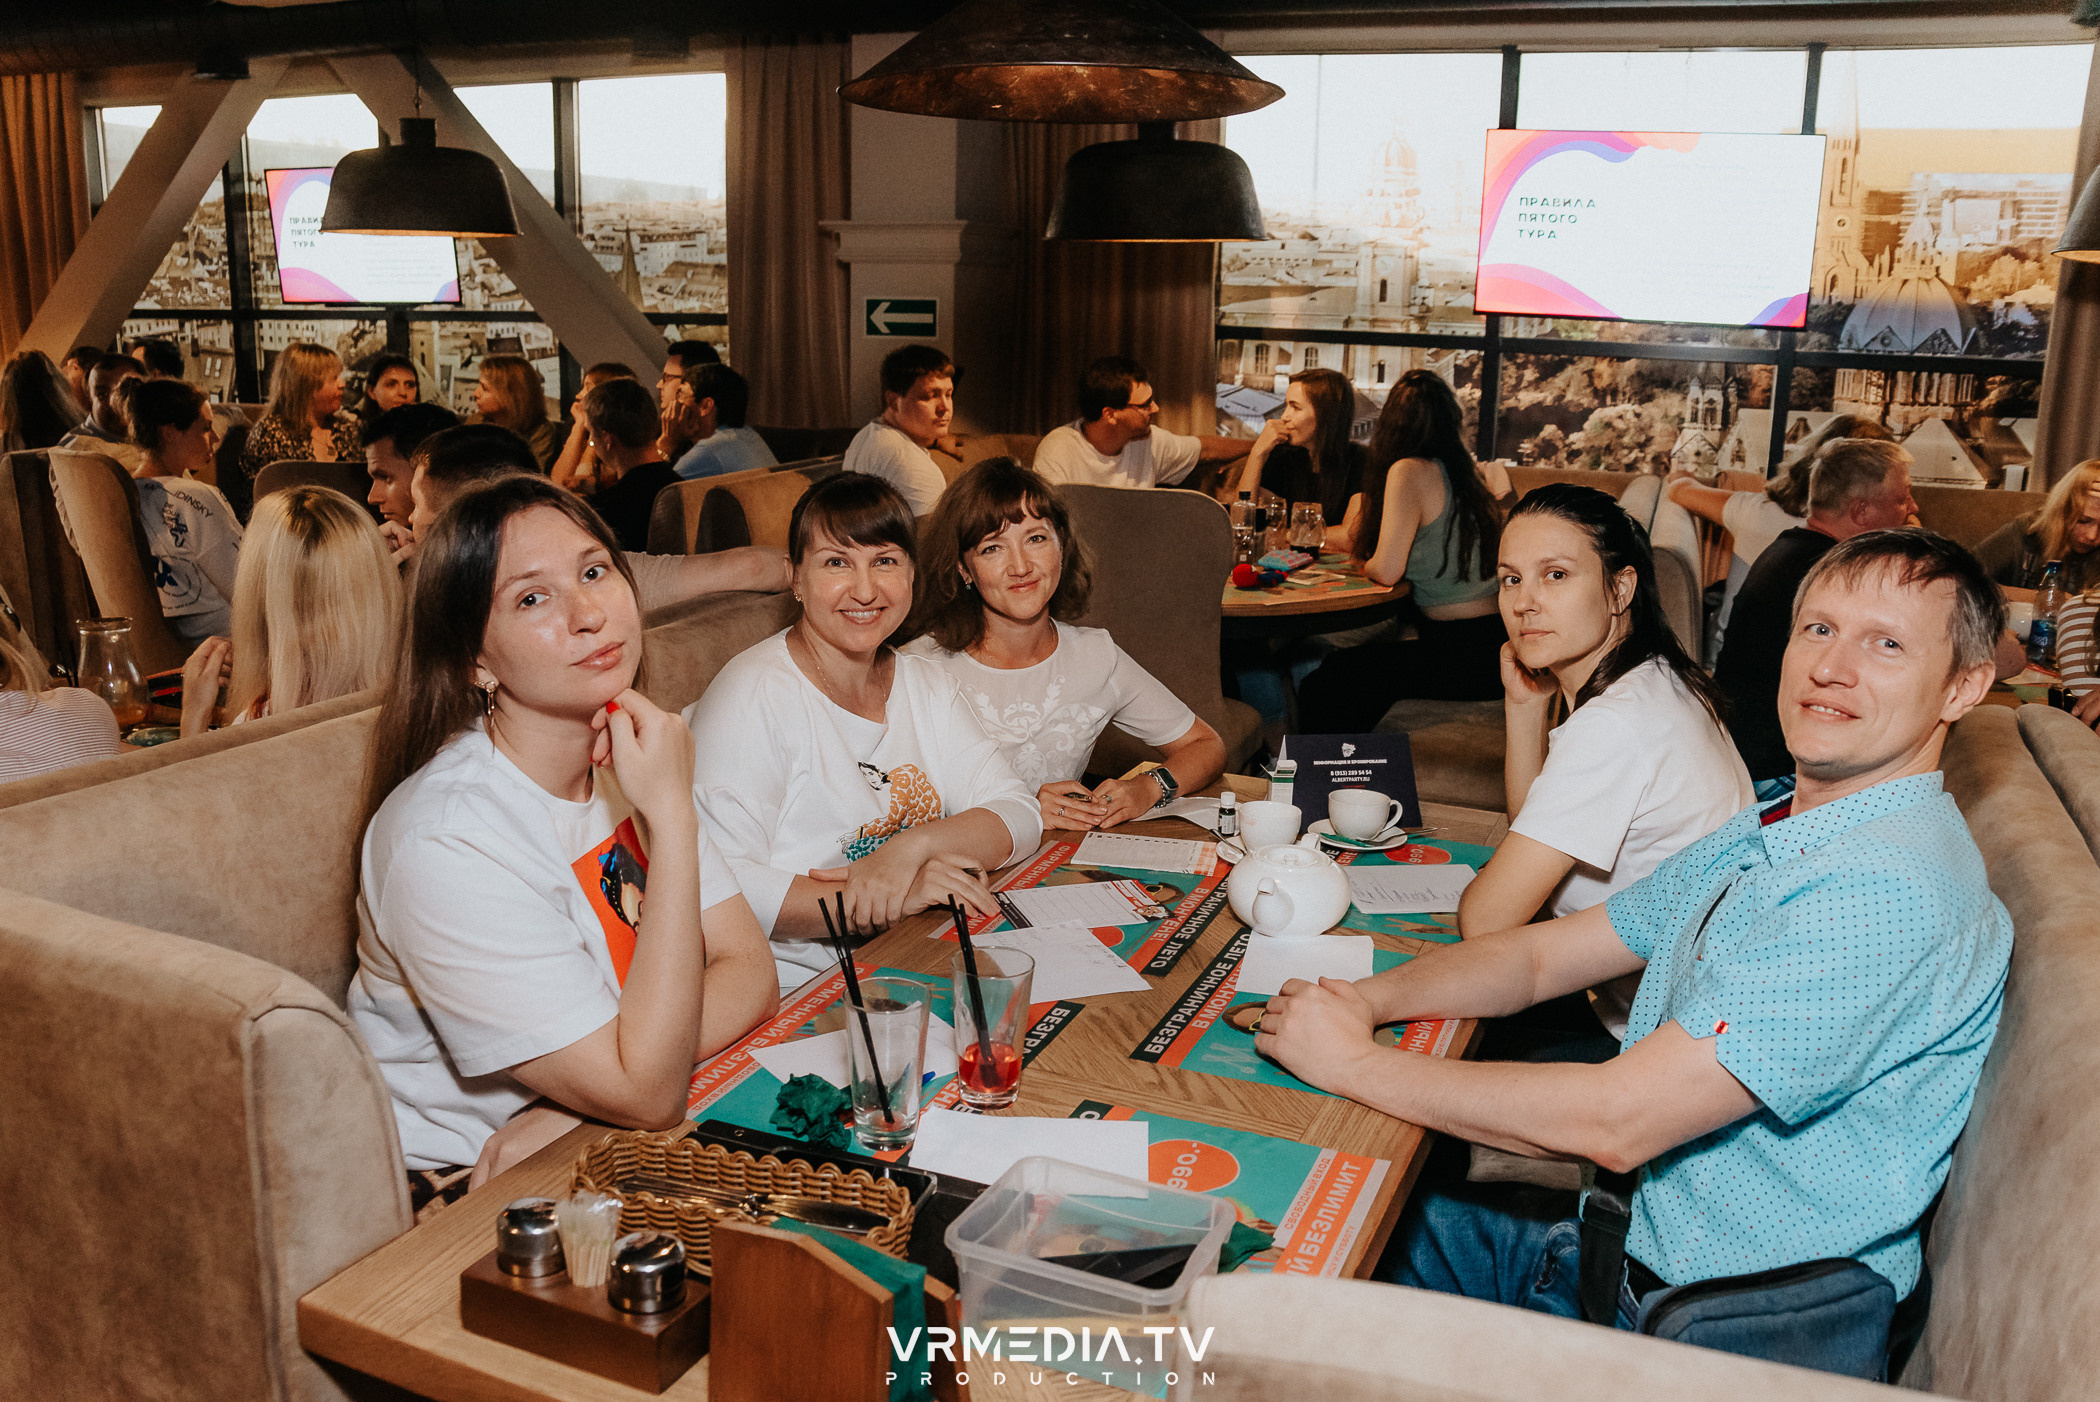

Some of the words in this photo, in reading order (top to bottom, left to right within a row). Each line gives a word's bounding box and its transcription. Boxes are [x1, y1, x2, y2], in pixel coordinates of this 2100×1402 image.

[1519, 197, 1596, 208] ПРАВИЛА
[289, 217, 323, 225] ПРАВИ
[1518, 213, 1578, 223] ПЯТОГО
[1518, 229, 1557, 239] ТУРА
[1150, 941, 1184, 968] ЛЕТО
[1144, 962, 1234, 1054] БЕЗГРАНИЧНОЕ
[1191, 1019, 1211, 1029] В
[1284, 1178, 1318, 1230] СВОБОДНЫЙ
[1313, 1157, 1332, 1180] ВХОД
[1298, 1161, 1361, 1257] БЕЗЛИМИТ
